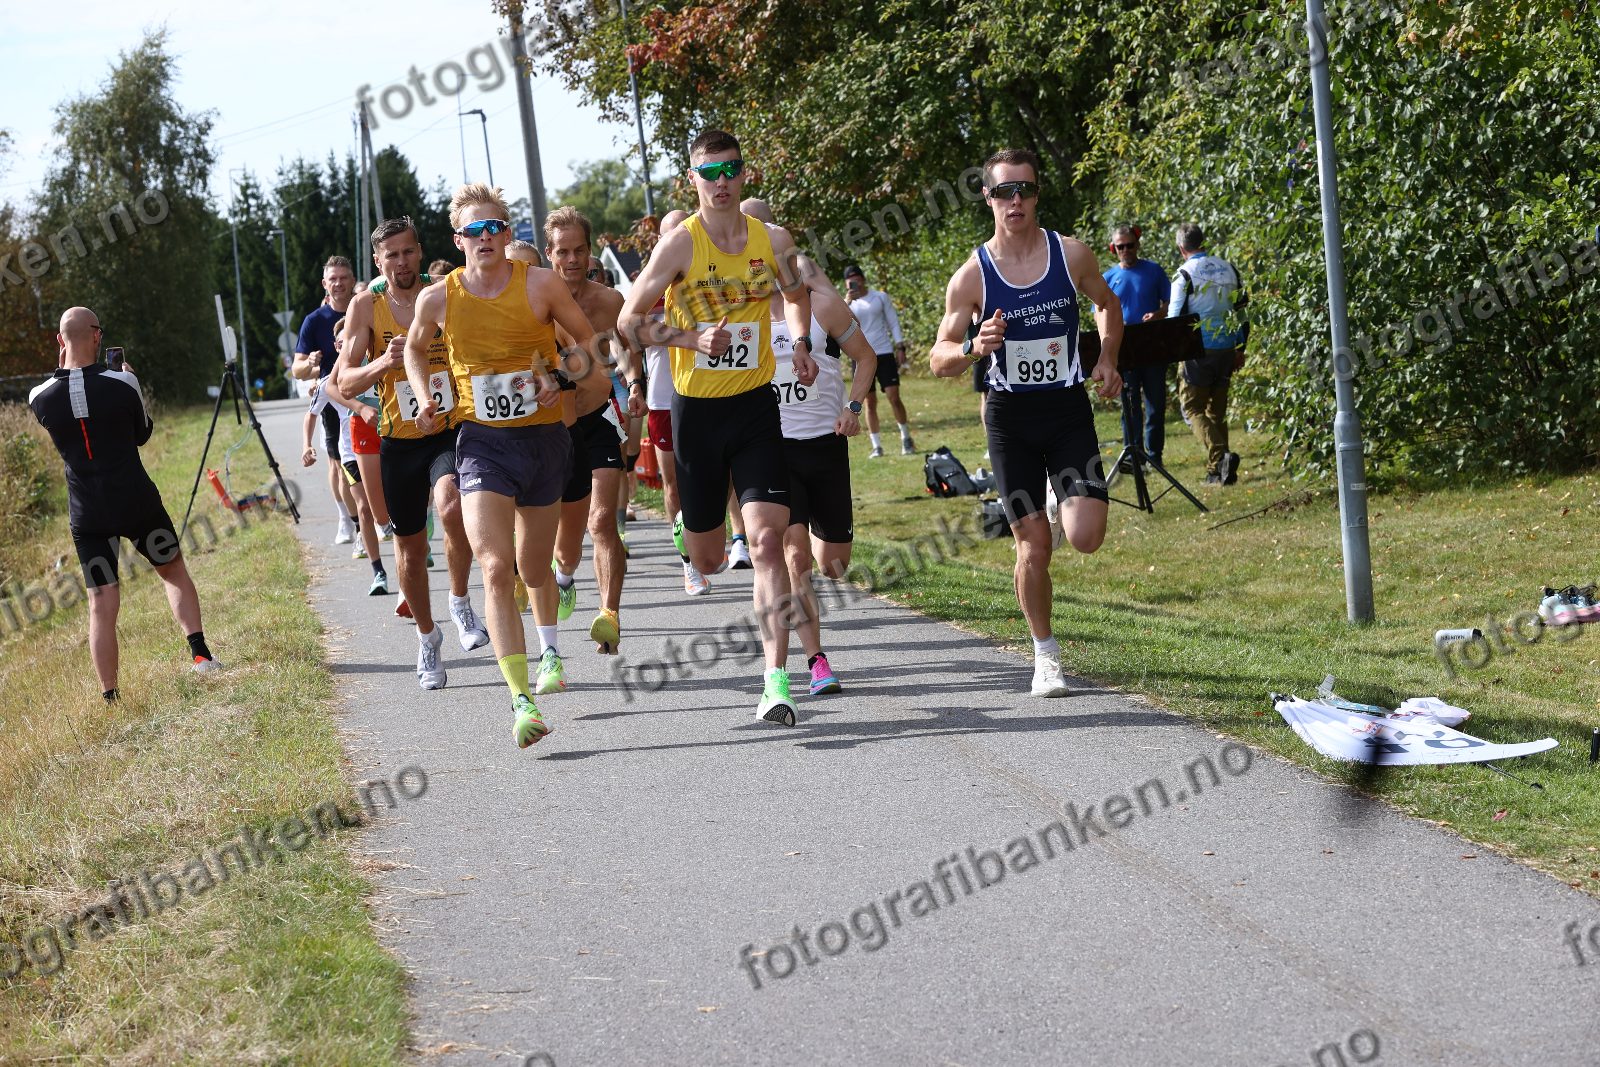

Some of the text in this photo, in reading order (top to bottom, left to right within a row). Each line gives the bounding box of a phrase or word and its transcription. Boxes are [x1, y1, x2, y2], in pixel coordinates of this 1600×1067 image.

[1001, 297, 1070, 321] PAREBANKEN
[1024, 314, 1047, 327] SØR
[1018, 359, 1058, 382] 993
[409, 392, 446, 417] 22
[485, 393, 526, 419] 992
